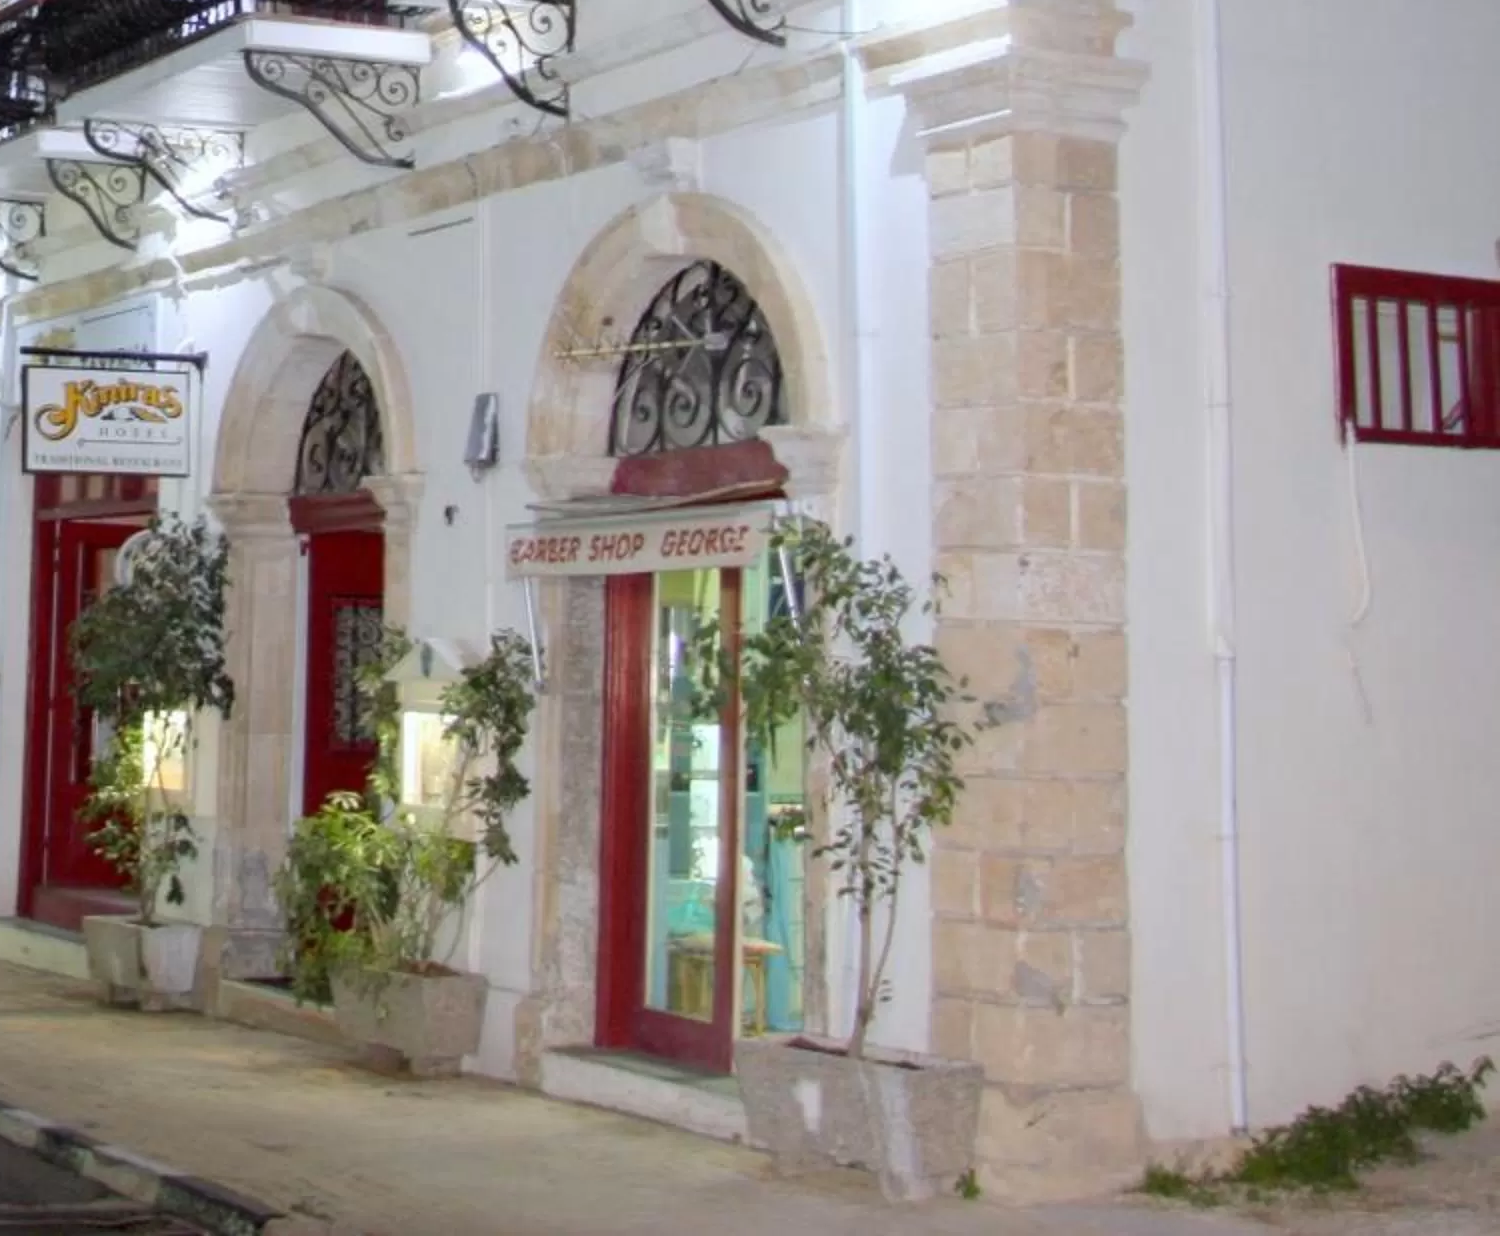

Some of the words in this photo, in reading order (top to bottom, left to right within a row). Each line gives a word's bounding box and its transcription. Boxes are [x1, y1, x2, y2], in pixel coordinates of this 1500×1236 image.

[99, 427, 169, 439] HOTEL
[509, 537, 581, 565] BARBER
[588, 533, 645, 562] SHOP
[659, 525, 750, 557] GEORGE
